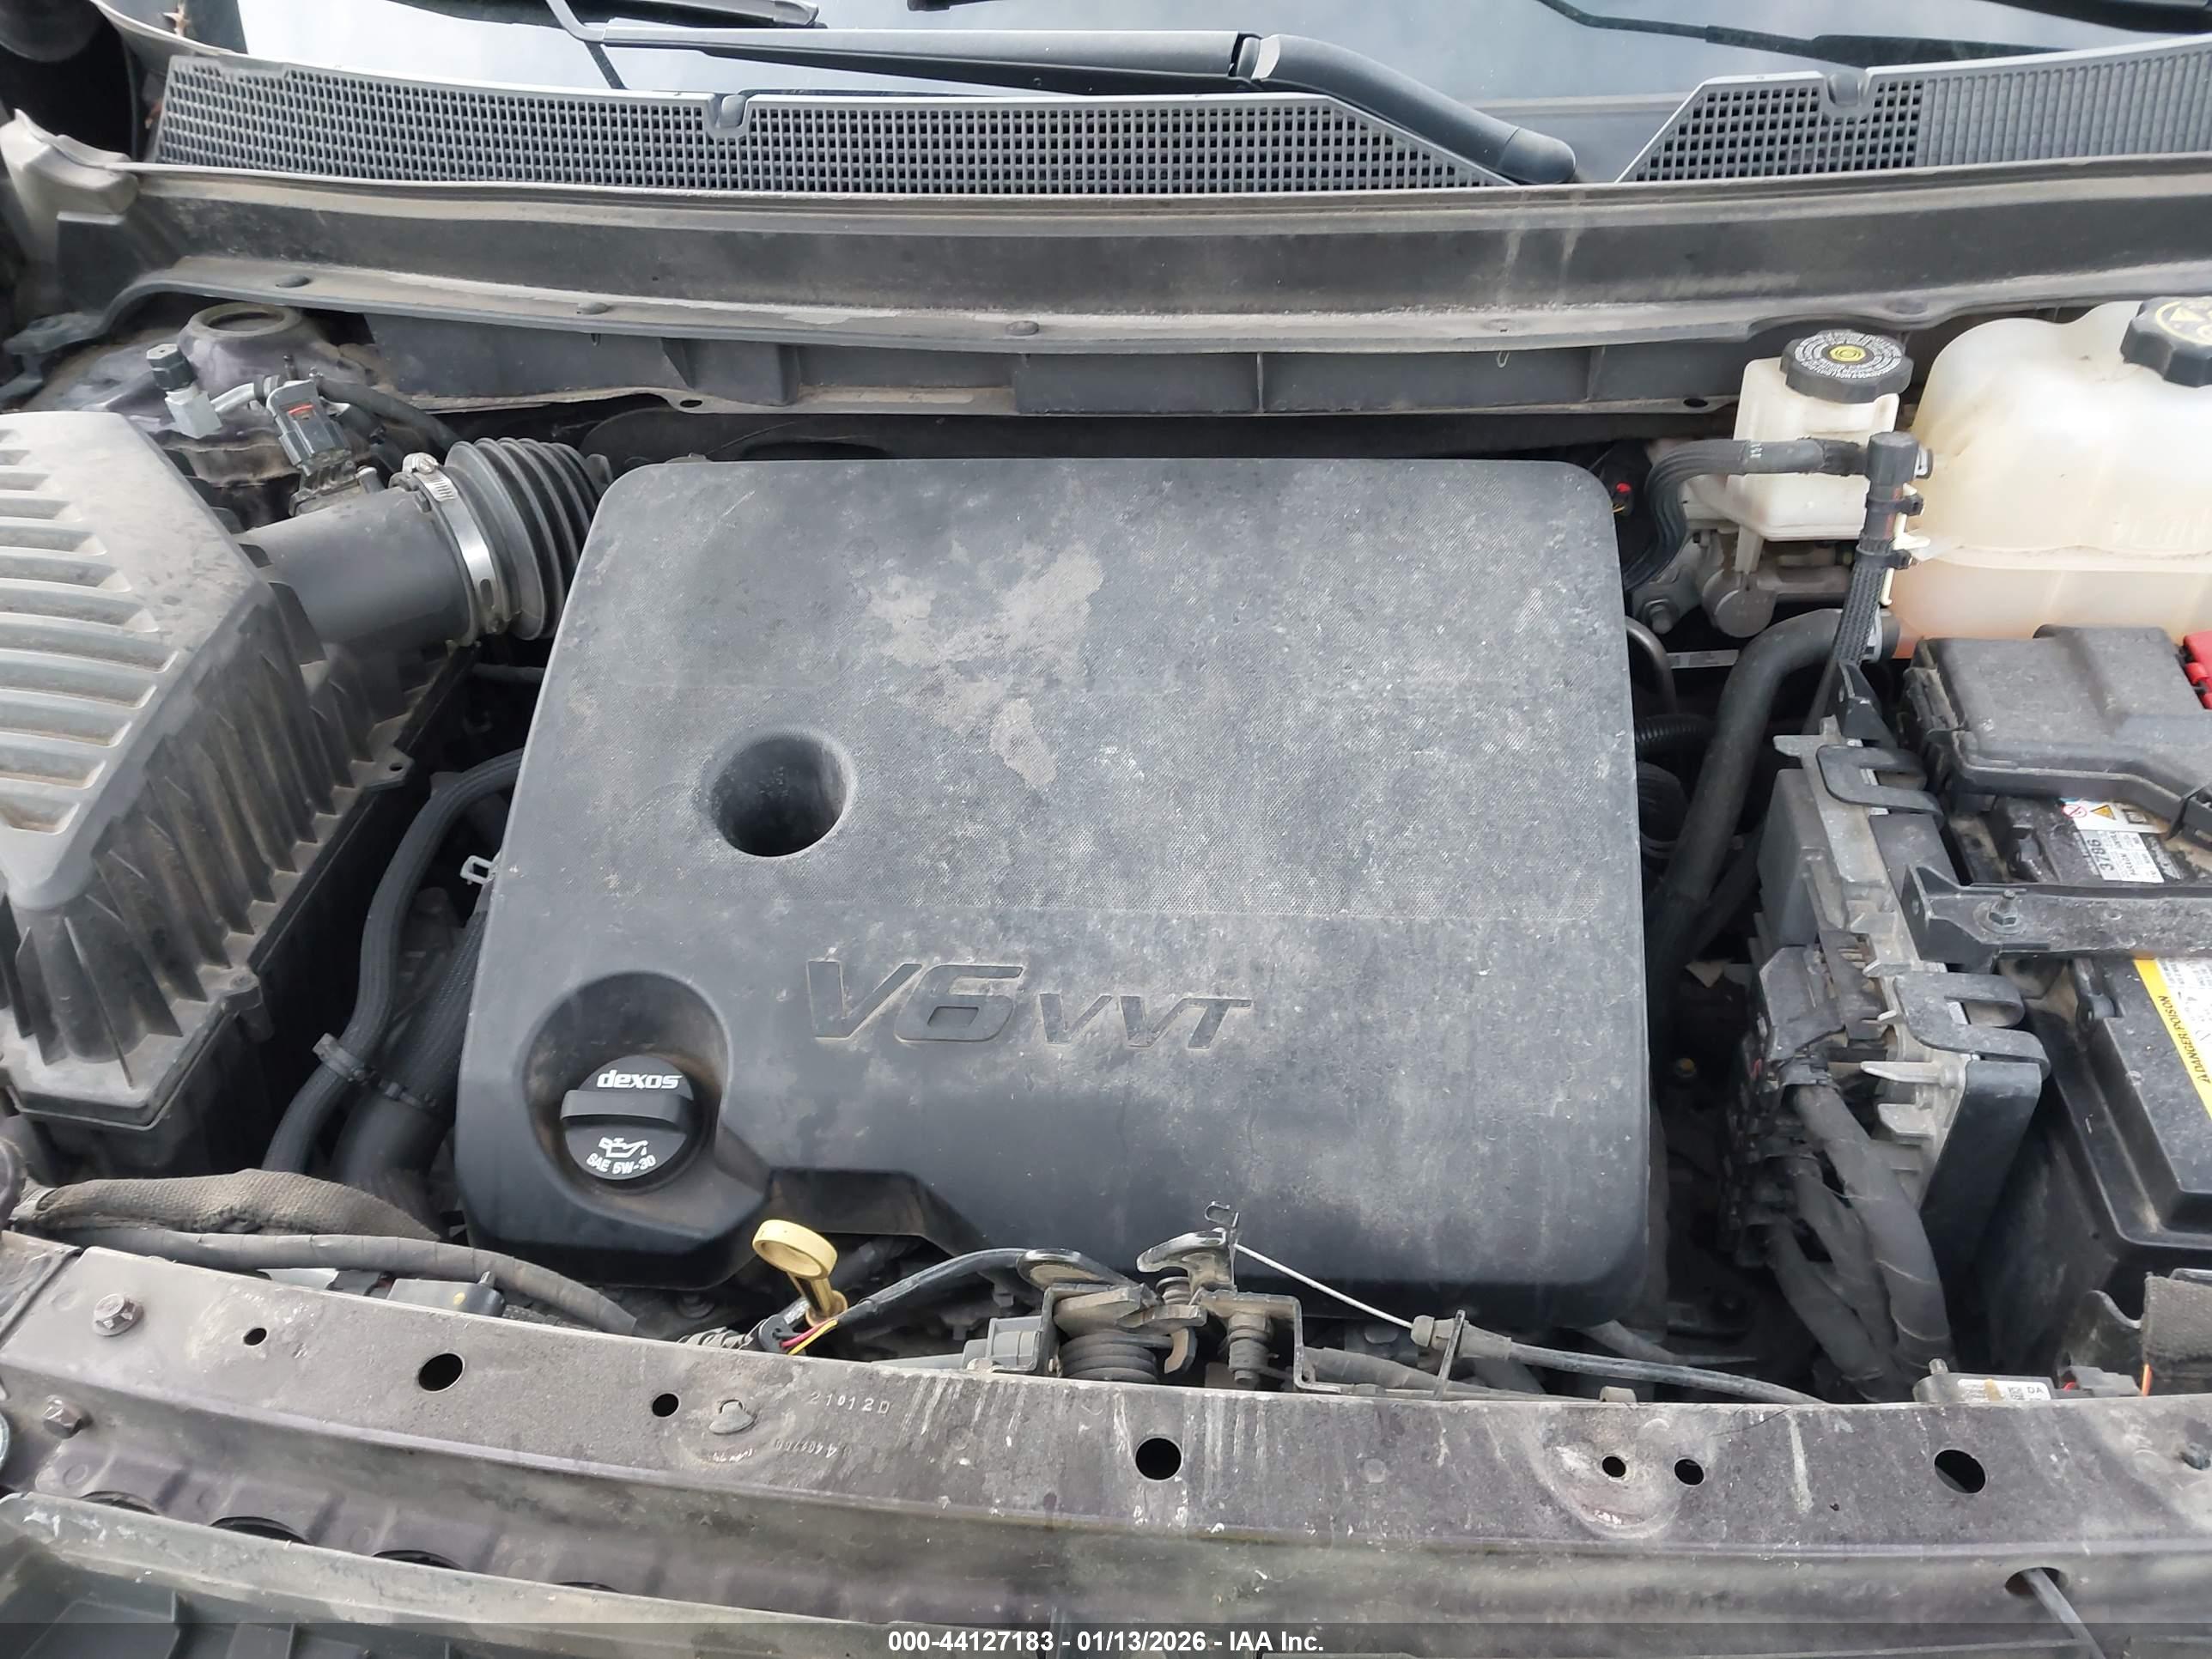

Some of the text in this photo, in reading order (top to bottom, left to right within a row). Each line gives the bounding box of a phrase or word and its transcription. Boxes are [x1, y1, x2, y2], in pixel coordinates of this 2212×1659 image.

[807, 960, 1253, 1049] V6 VVT
[597, 1070, 683, 1089] dexos
[586, 1153, 656, 1174] SAE 5W-30
